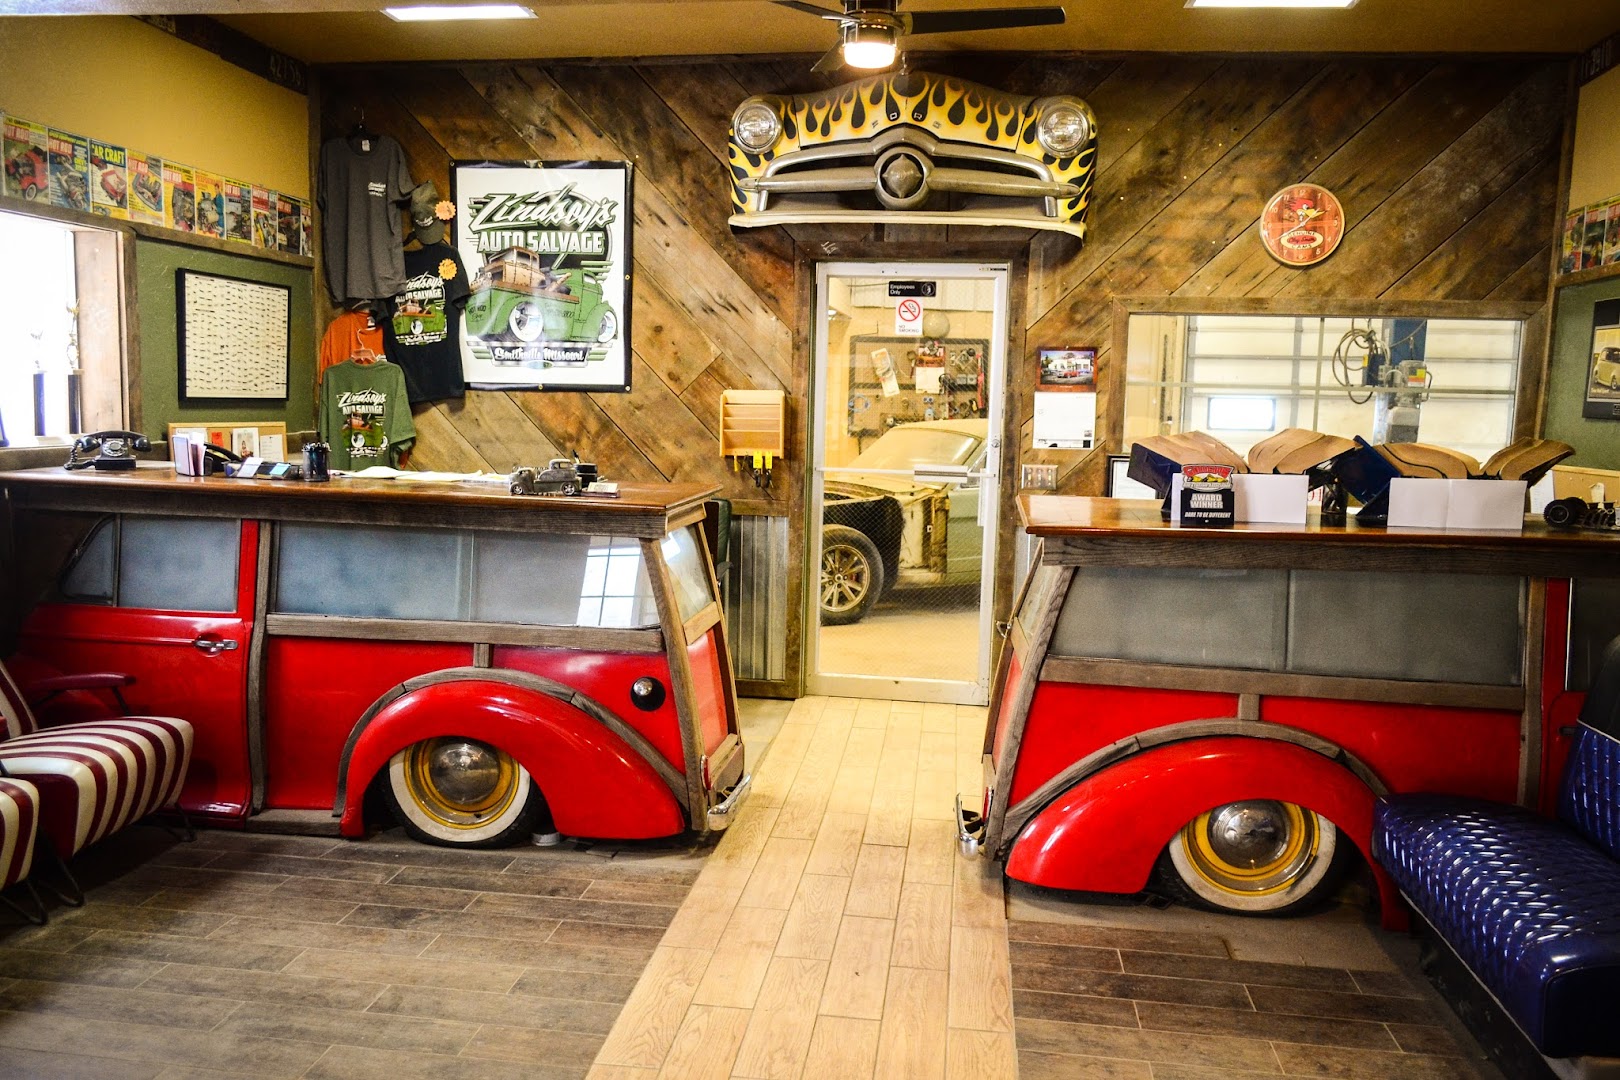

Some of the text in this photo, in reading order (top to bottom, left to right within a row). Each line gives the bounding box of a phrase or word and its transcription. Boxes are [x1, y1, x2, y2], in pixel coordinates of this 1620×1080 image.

[872, 112, 942, 129] FORD
[104, 146, 125, 166] CRAFT
[470, 182, 617, 232] Lindsey's
[479, 231, 604, 253] AUTO SALVAGE
[414, 288, 442, 301] SALVAGE
[543, 347, 585, 361] Missouri
[1191, 493, 1222, 501] AWARD
[1190, 500, 1223, 509] WINNER
[1209, 511, 1231, 519] DIFFERENT
